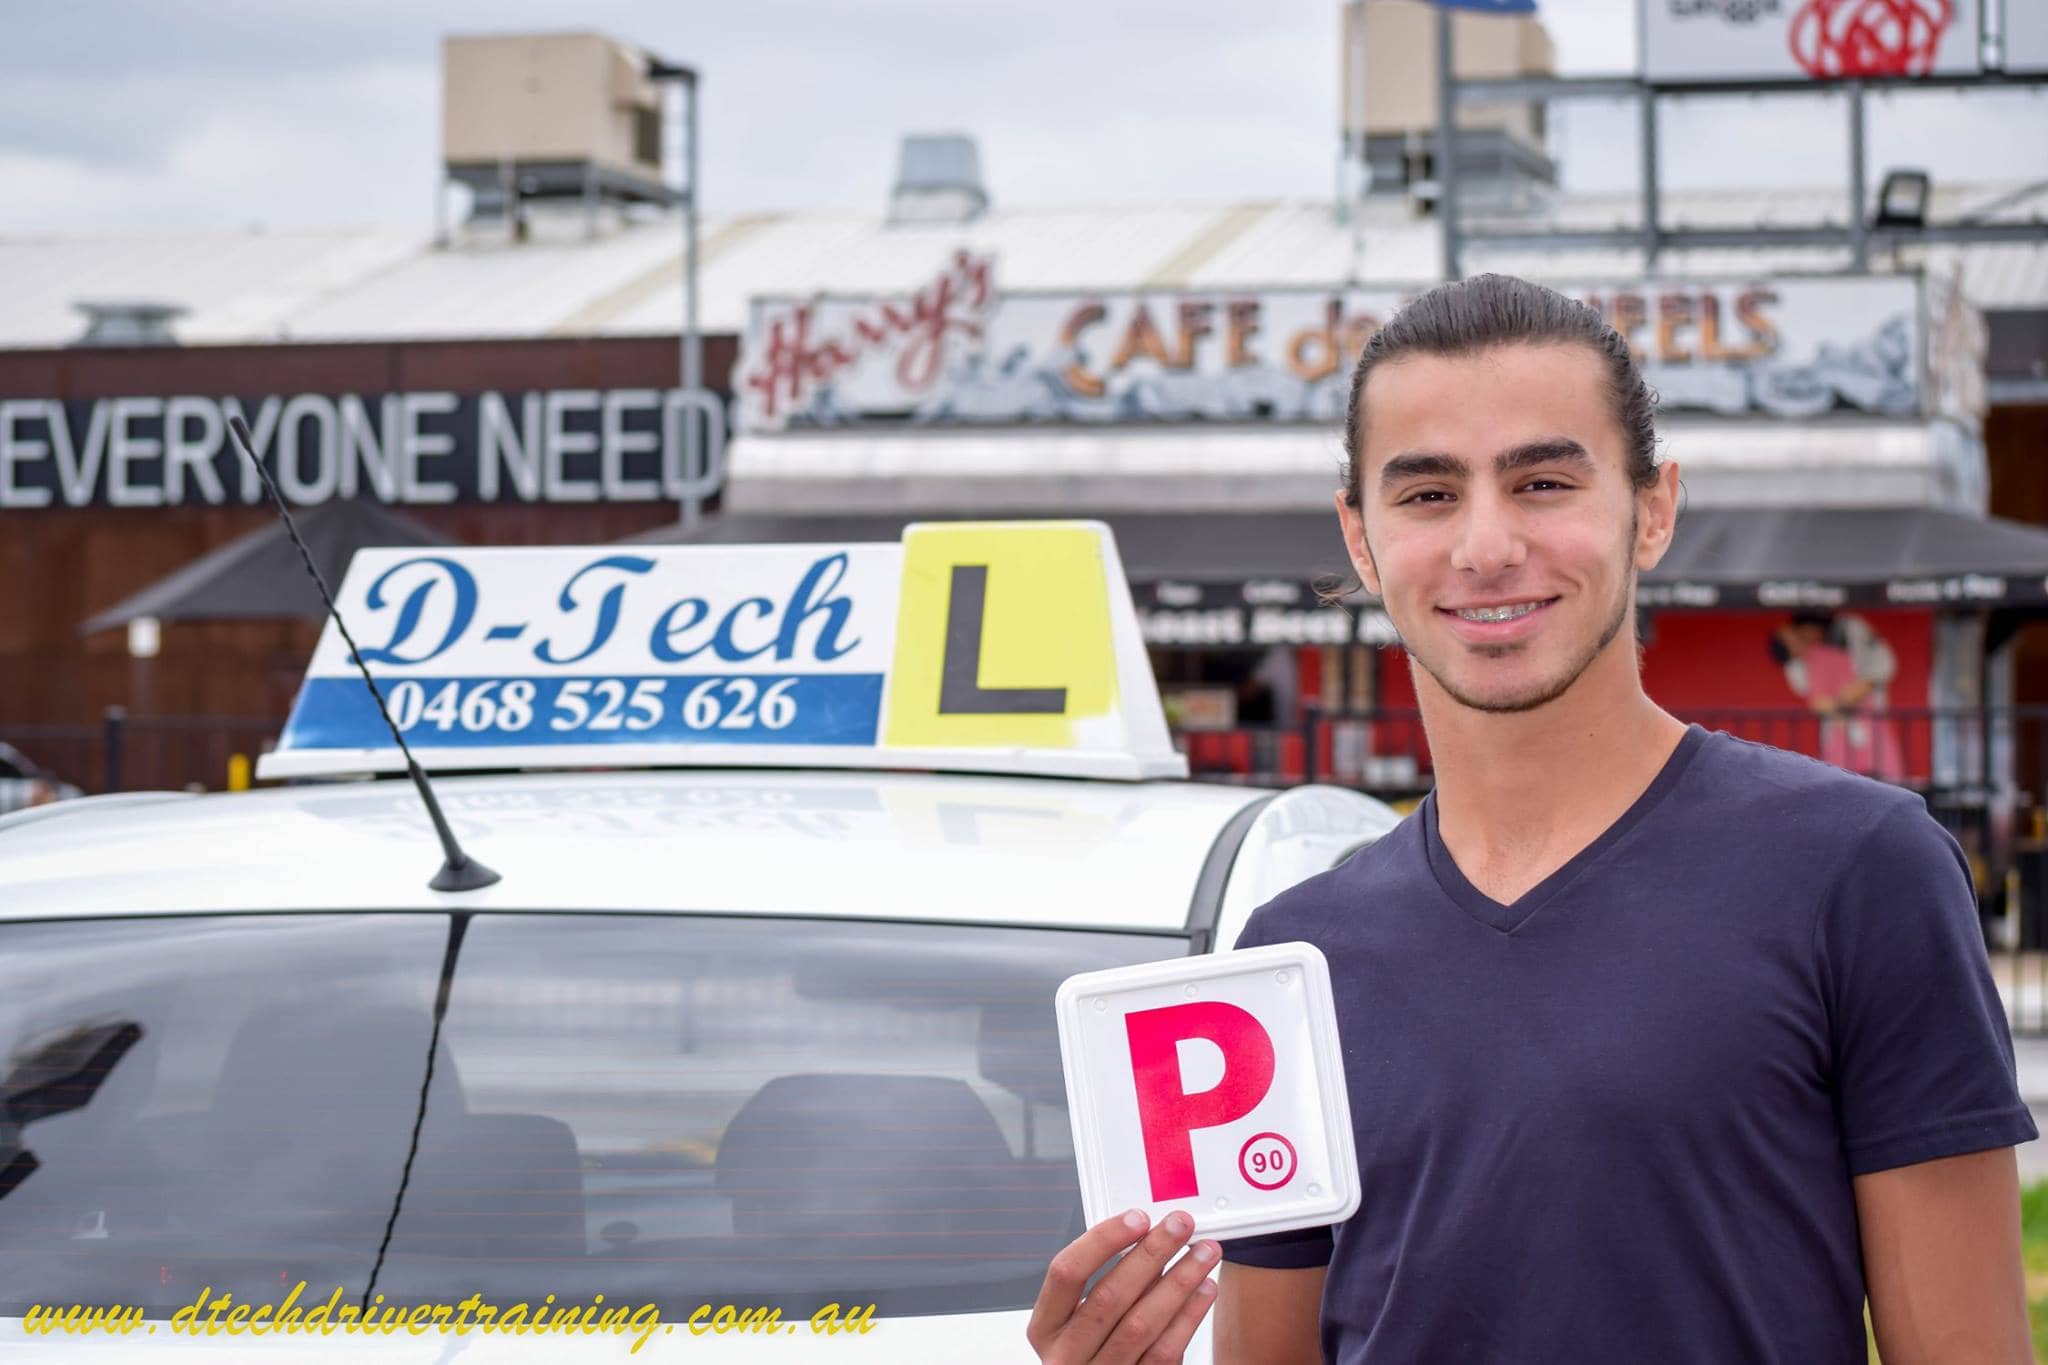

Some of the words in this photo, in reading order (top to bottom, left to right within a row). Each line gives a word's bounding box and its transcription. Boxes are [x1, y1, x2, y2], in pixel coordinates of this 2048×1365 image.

[746, 248, 992, 418] Harry's
[1058, 298, 1264, 397] CAFE
[1588, 289, 1782, 364] EELS
[0, 395, 460, 508] EVERYONE
[478, 389, 727, 503] NEED
[347, 552, 863, 667] D-Tech
[938, 565, 1067, 715] L
[386, 679, 537, 732] 0468
[550, 679, 668, 732] 525
[682, 678, 801, 731] 626
[1124, 1001, 1276, 1203] P
[1251, 1149, 1284, 1174] 90
